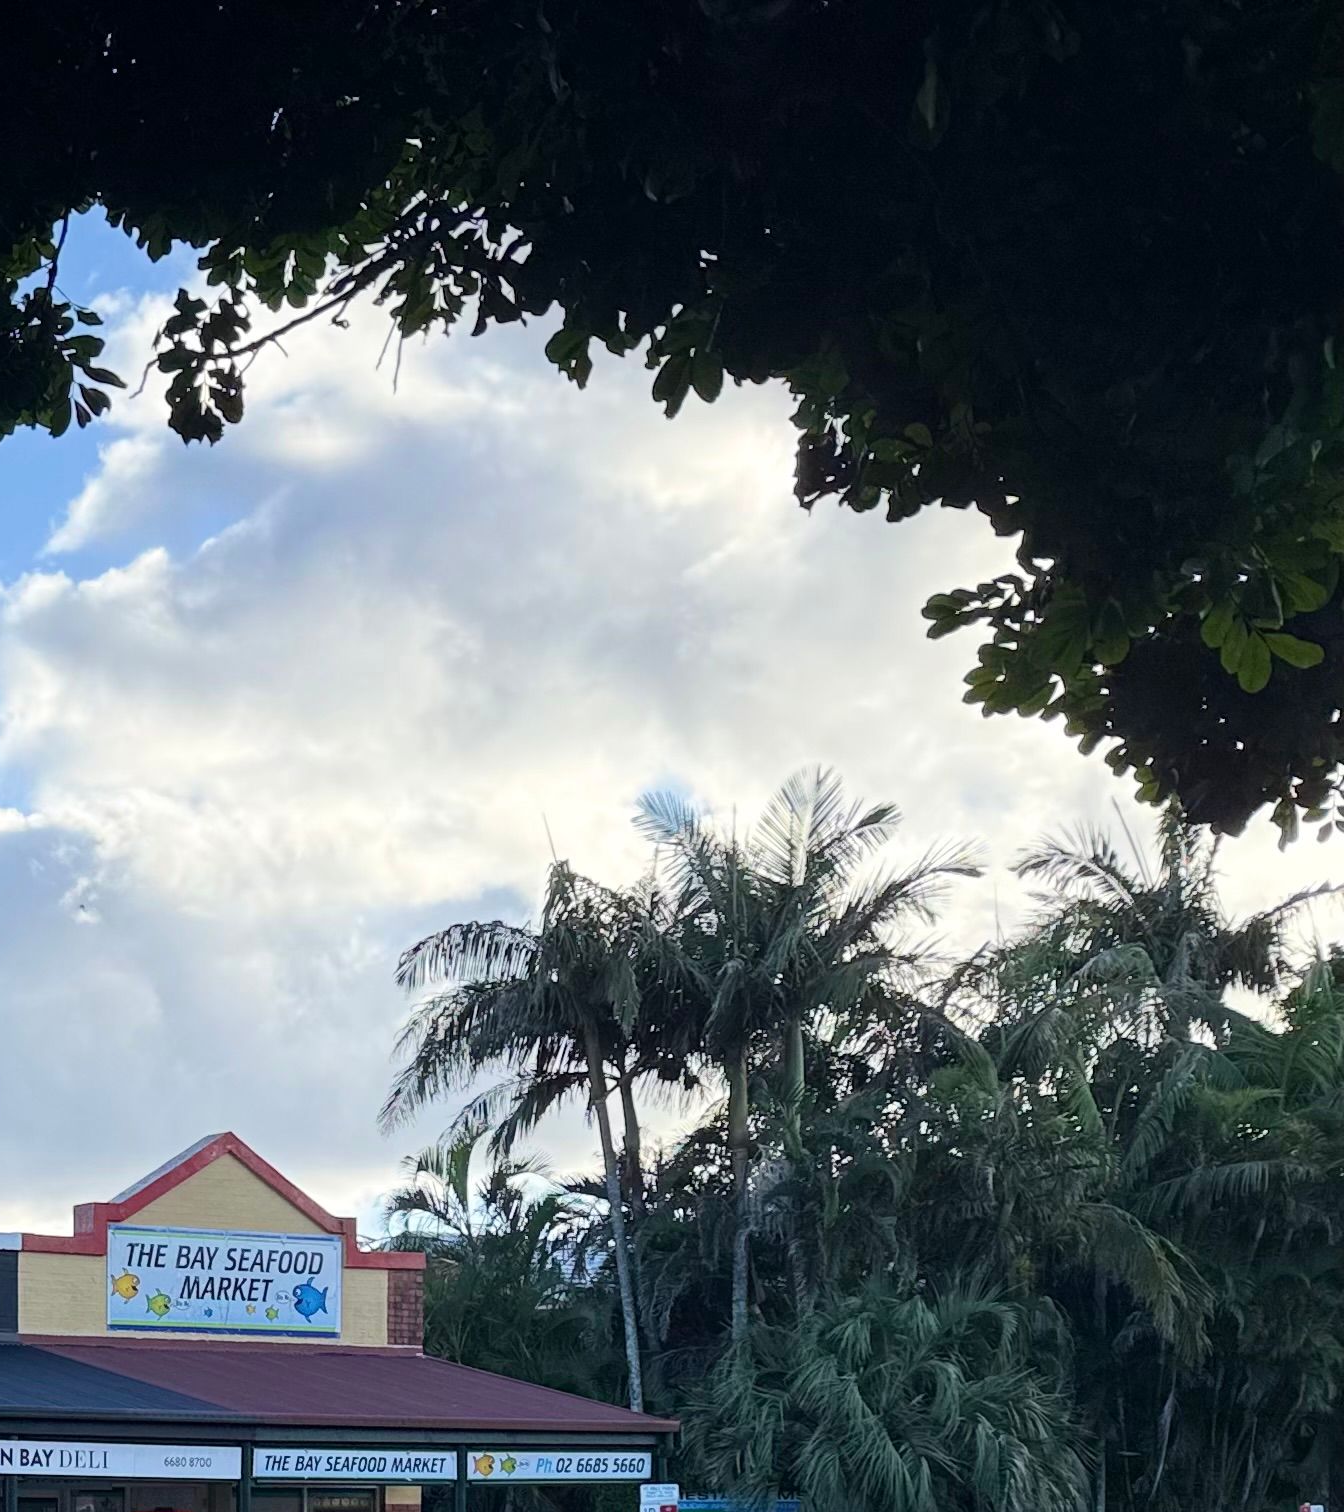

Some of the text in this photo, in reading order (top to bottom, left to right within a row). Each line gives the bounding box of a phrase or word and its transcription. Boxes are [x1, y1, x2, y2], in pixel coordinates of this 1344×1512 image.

[125, 1241, 325, 1276] THE BAY SEAFOOD
[178, 1275, 274, 1303] MARKET
[19, 1448, 55, 1468] BAY
[59, 1450, 110, 1470] DELI
[163, 1456, 212, 1468] 6680 8700
[264, 1455, 447, 1474] THE BAY SEAFOOD MARKET
[575, 1457, 609, 1474] 6685
[612, 1457, 646, 1474] 5660
